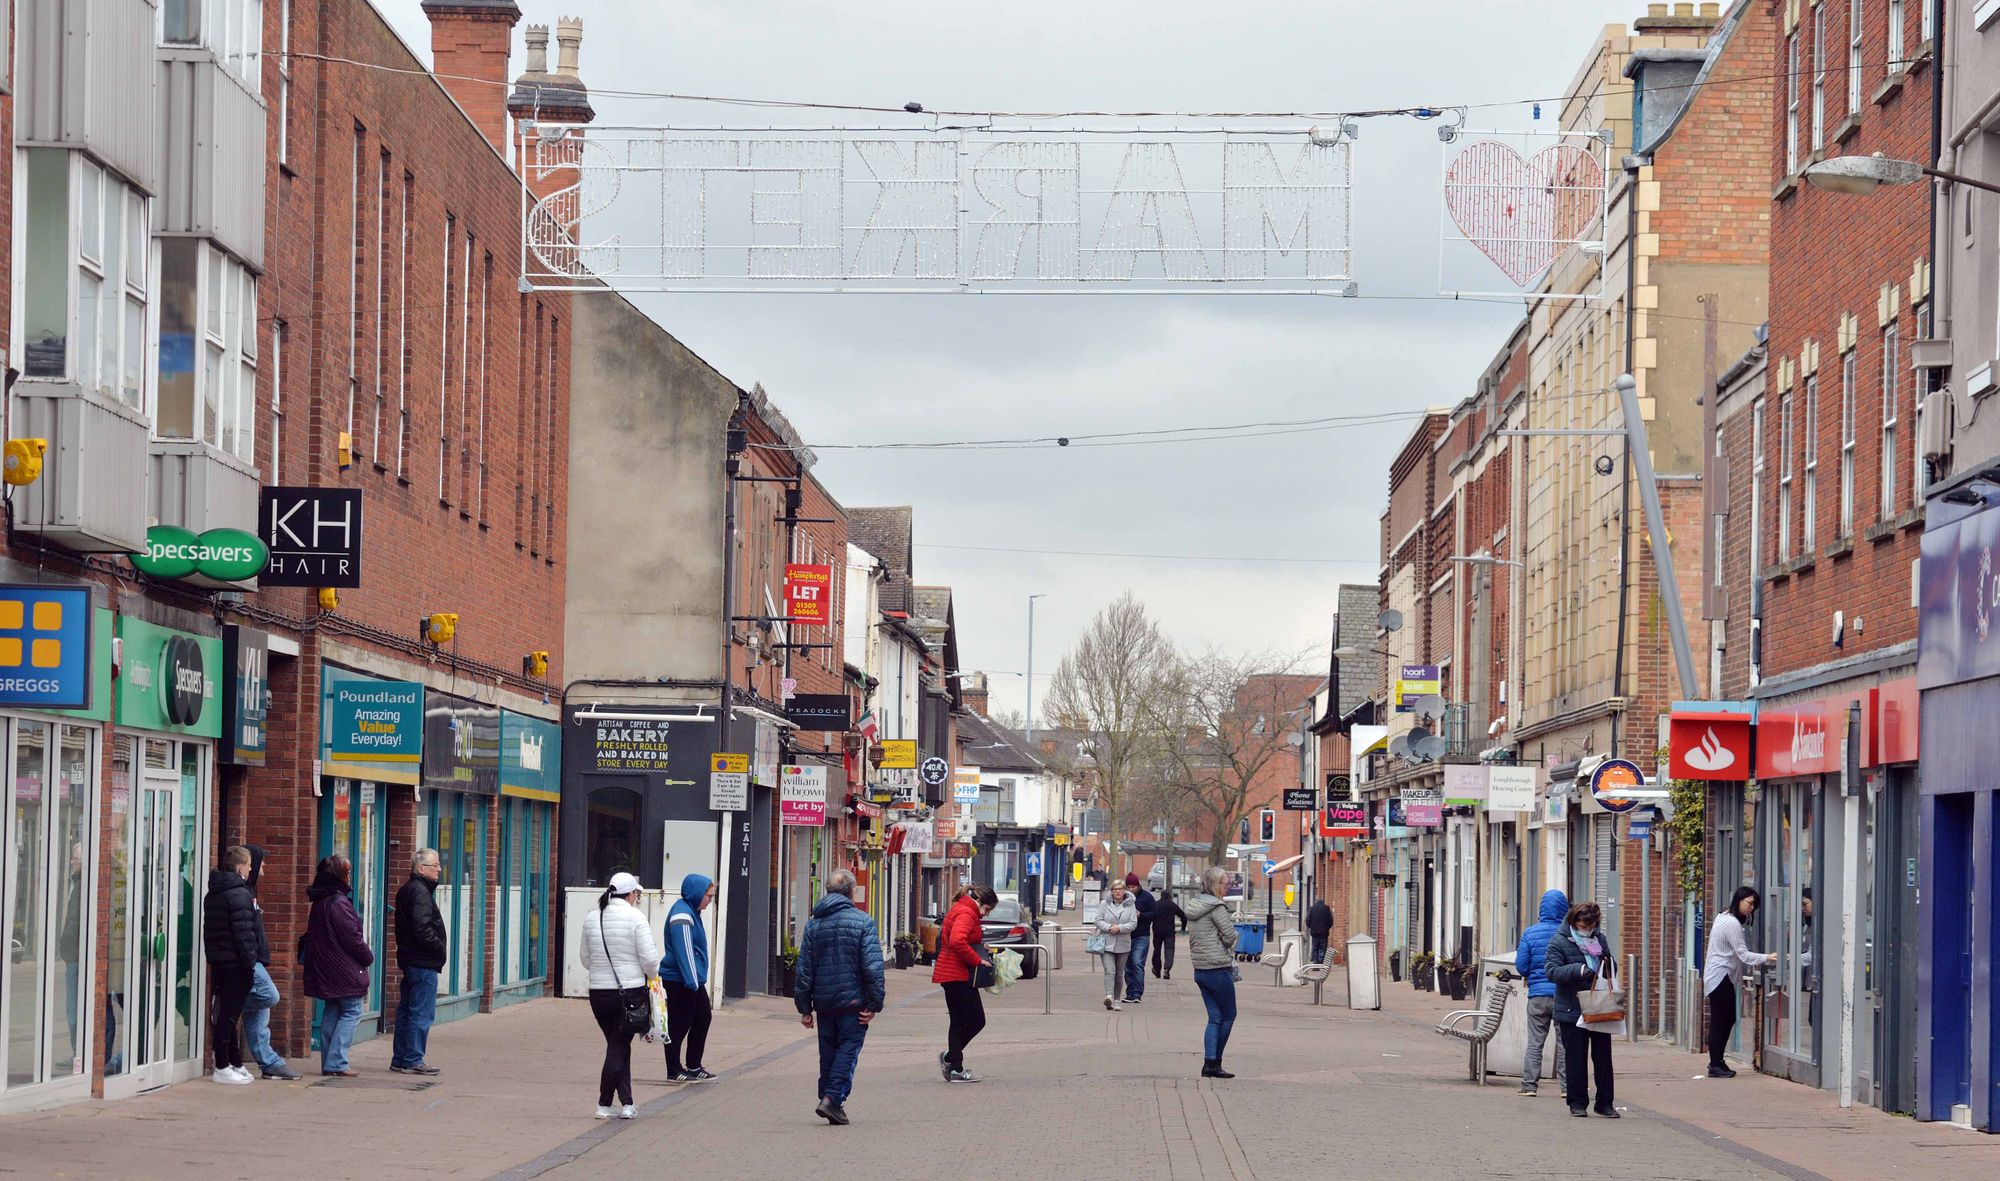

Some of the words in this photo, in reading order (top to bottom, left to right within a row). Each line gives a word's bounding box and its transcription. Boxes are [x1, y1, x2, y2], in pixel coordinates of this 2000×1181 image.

[271, 498, 351, 549] KH
[270, 557, 349, 575] HAIR
[792, 585, 820, 600] LET
[1403, 667, 1425, 676] haart
[339, 690, 416, 704] Poundland
[354, 708, 401, 723] Amazing
[358, 720, 396, 733] Value
[597, 720, 624, 728] ARTISAN
[629, 721, 651, 729] COFFEE
[657, 721, 670, 729] AND
[351, 732, 402, 748] Everyday!
[596, 728, 669, 742] BAKERY
[596, 741, 637, 750] FRESHLY
[639, 743, 668, 751] ROLLED
[596, 750, 618, 758] AND
[620, 751, 657, 760] BAKED
[659, 751, 669, 760] IN
[596, 759, 622, 768] STORE
[626, 760, 651, 769] EVERY
[654, 761, 669, 769] DAY
[783, 776, 819, 786] william
[783, 786, 790, 796] h
[792, 786, 825, 797] brown
[962, 785, 978, 794] FHP
[1289, 791, 1311, 799] Phone
[1402, 790, 1431, 798] MAKEUP
[792, 802, 808, 810] Let
[811, 802, 824, 813] by
[1329, 807, 1364, 821] Vape
[742, 822, 750, 852] EAT
[741, 857, 749, 877] IN
